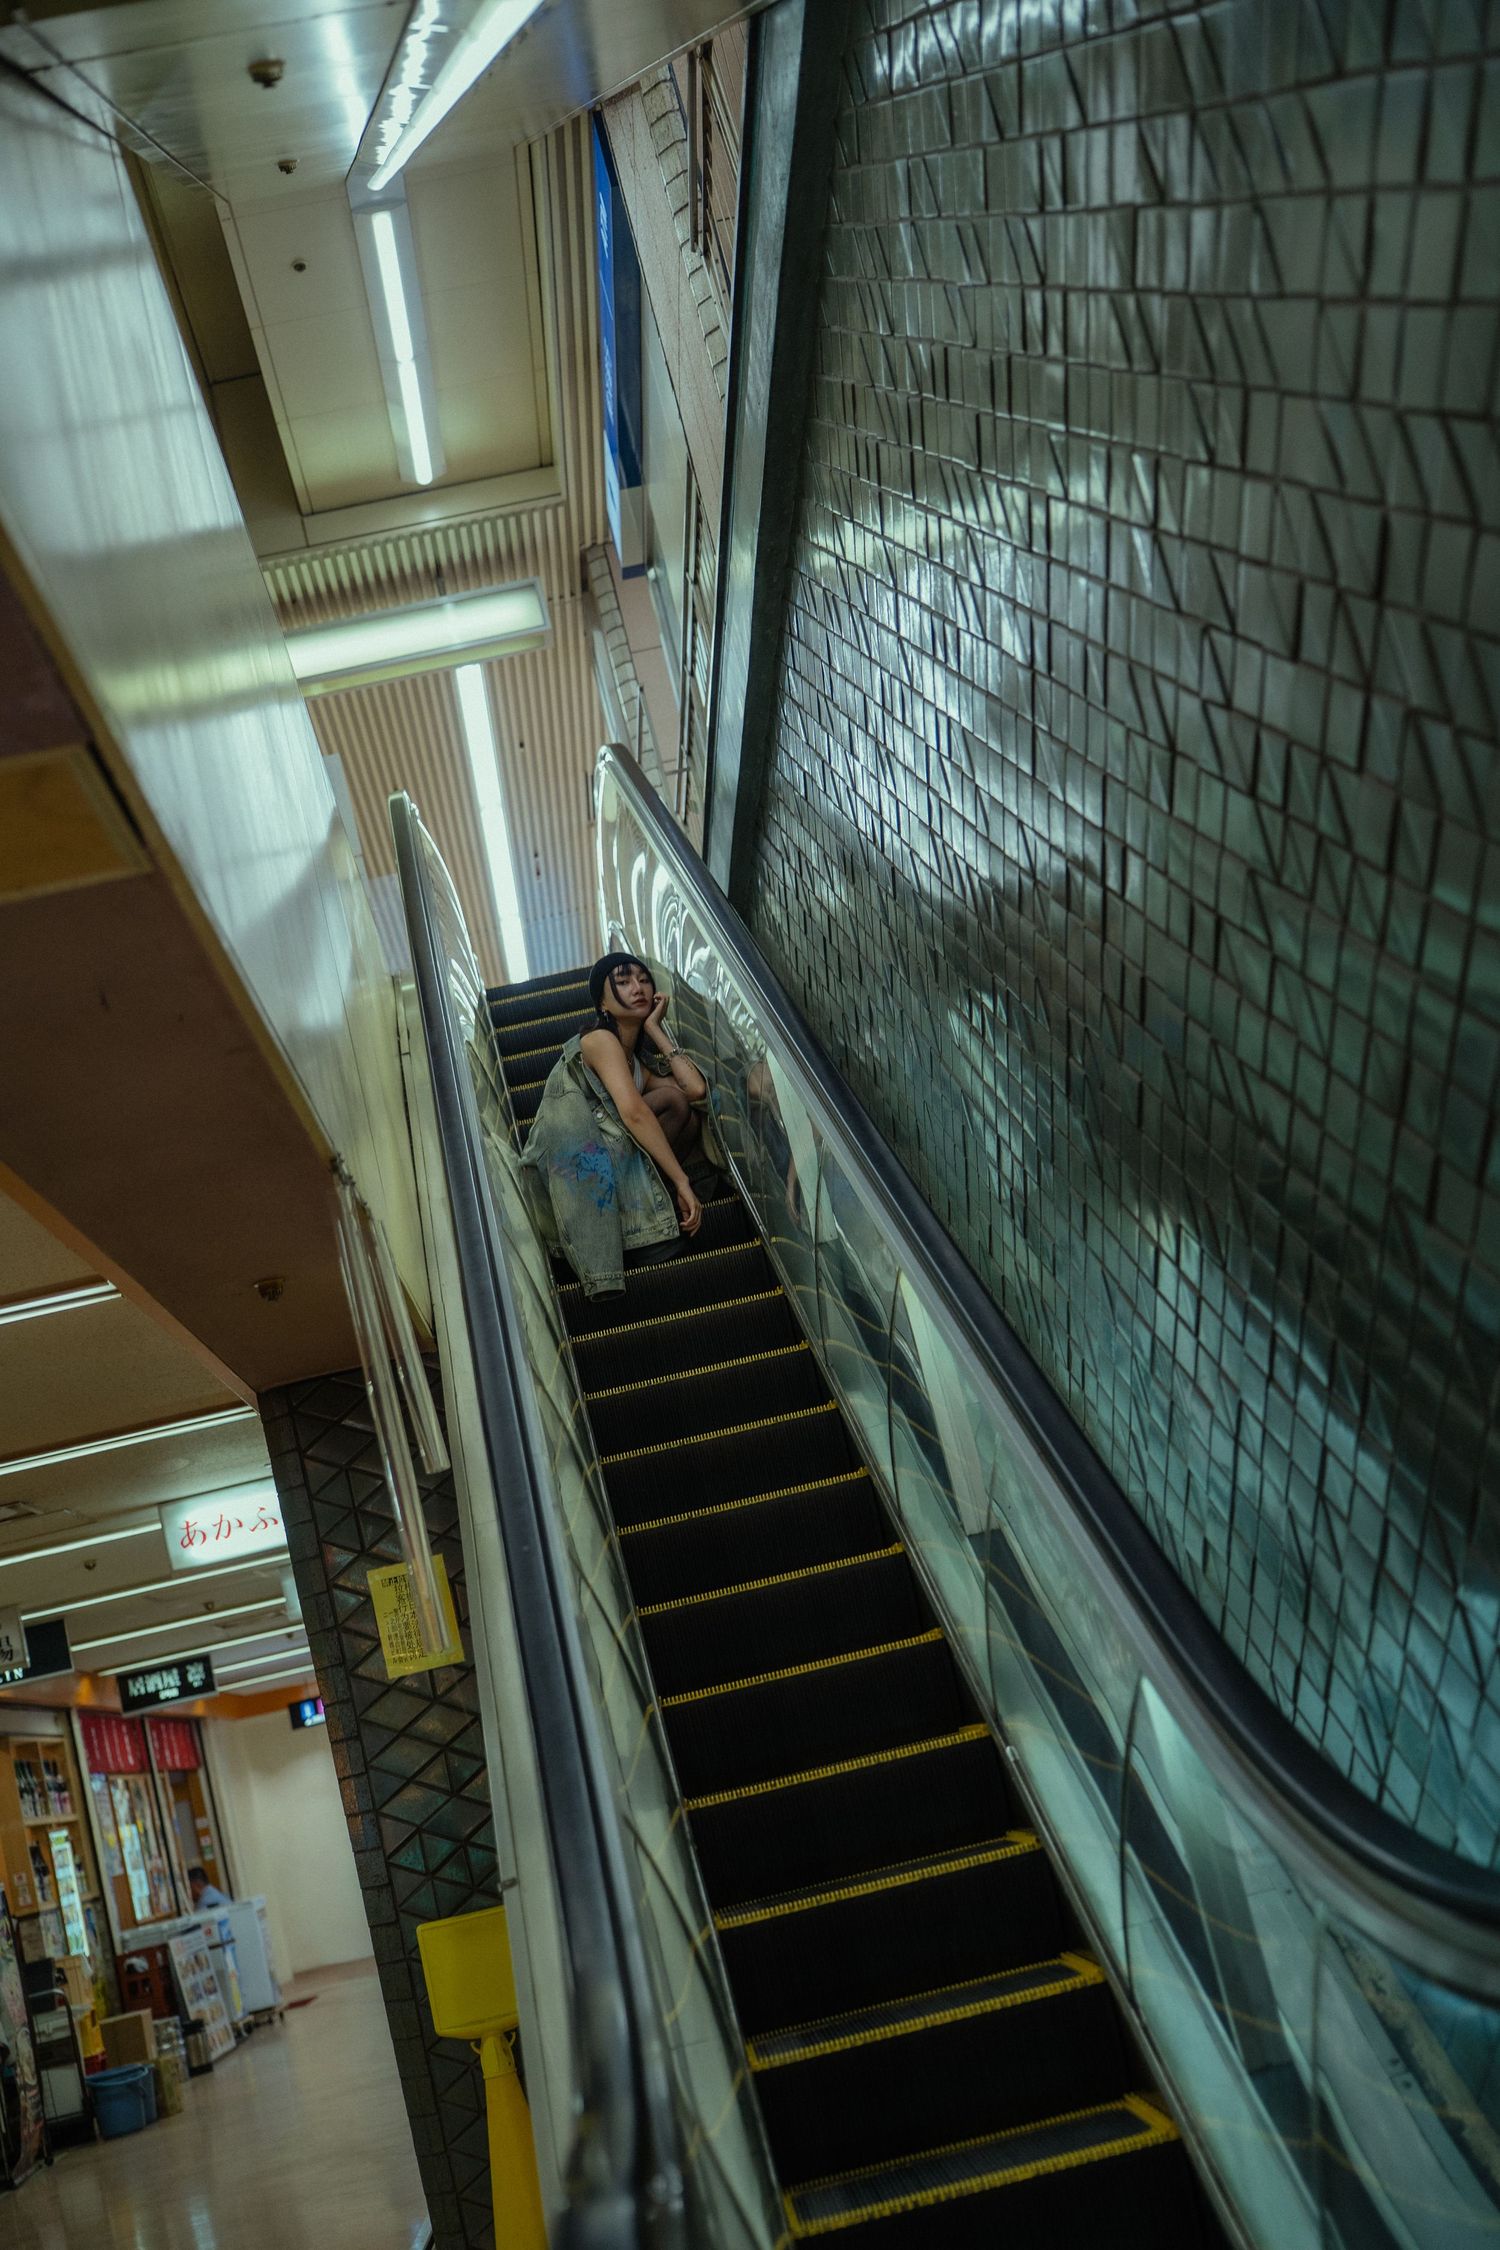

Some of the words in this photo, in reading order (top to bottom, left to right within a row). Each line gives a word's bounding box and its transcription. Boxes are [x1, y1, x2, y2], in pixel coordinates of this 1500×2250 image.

[180, 1507, 279, 1549] あかふ
[0, 1667, 23, 1684] IN
